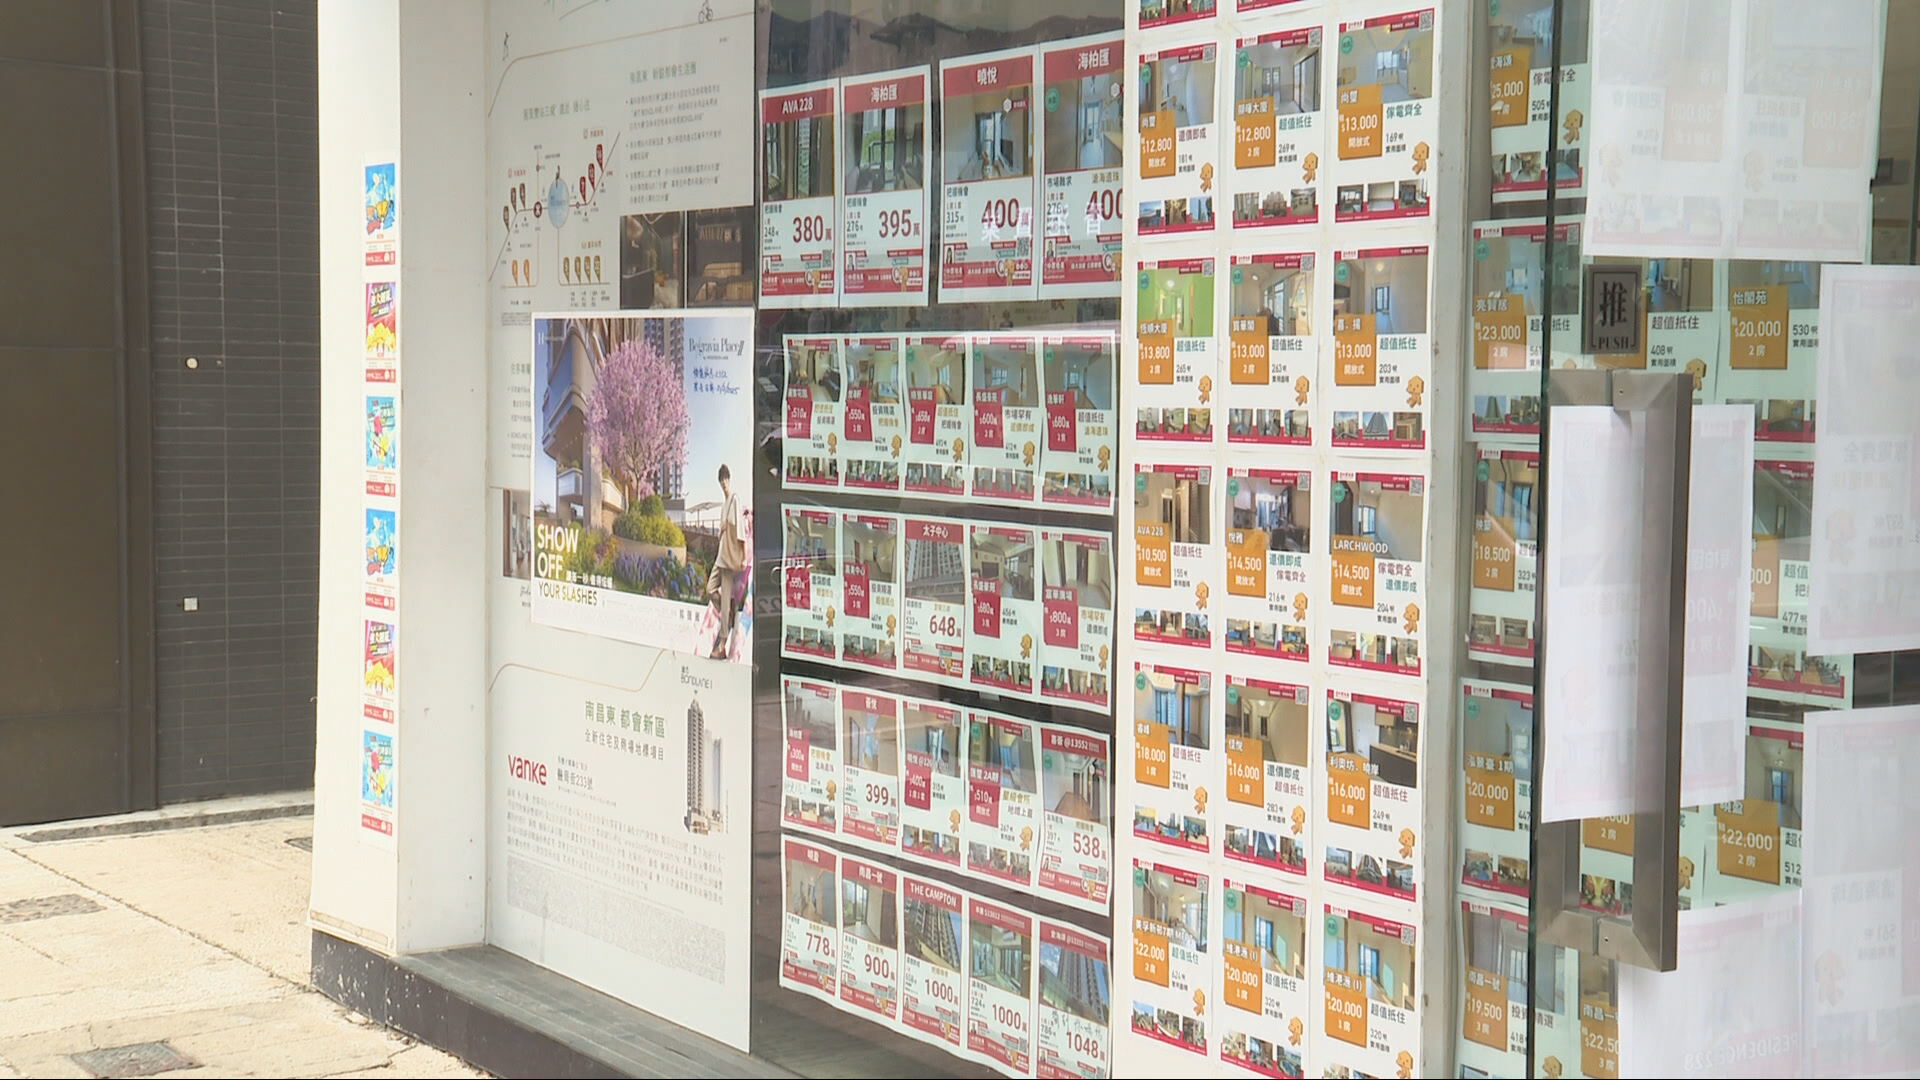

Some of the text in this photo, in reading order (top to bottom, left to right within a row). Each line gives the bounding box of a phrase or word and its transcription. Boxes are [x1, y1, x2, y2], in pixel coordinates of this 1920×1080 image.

[782, 98, 813, 114] AVA 228
[1599, 281, 1628, 327] 推
[1530, 318, 1570, 332] 超抵住
[1651, 316, 1699, 330] 超值抵住
[1598, 336, 1630, 349] PUSH
[537, 524, 579, 553] SHOW
[1333, 540, 1388, 554] LARCHWOOD
[537, 554, 563, 579] OFF
[539, 580, 560, 600] YOUR
[562, 584, 598, 607] SLASHES
[584, 700, 666, 738] 南昌東 都會新區
[910, 882, 957, 907] THE CAMPTON
[1584, 1004, 1618, 1021] 南昌一
